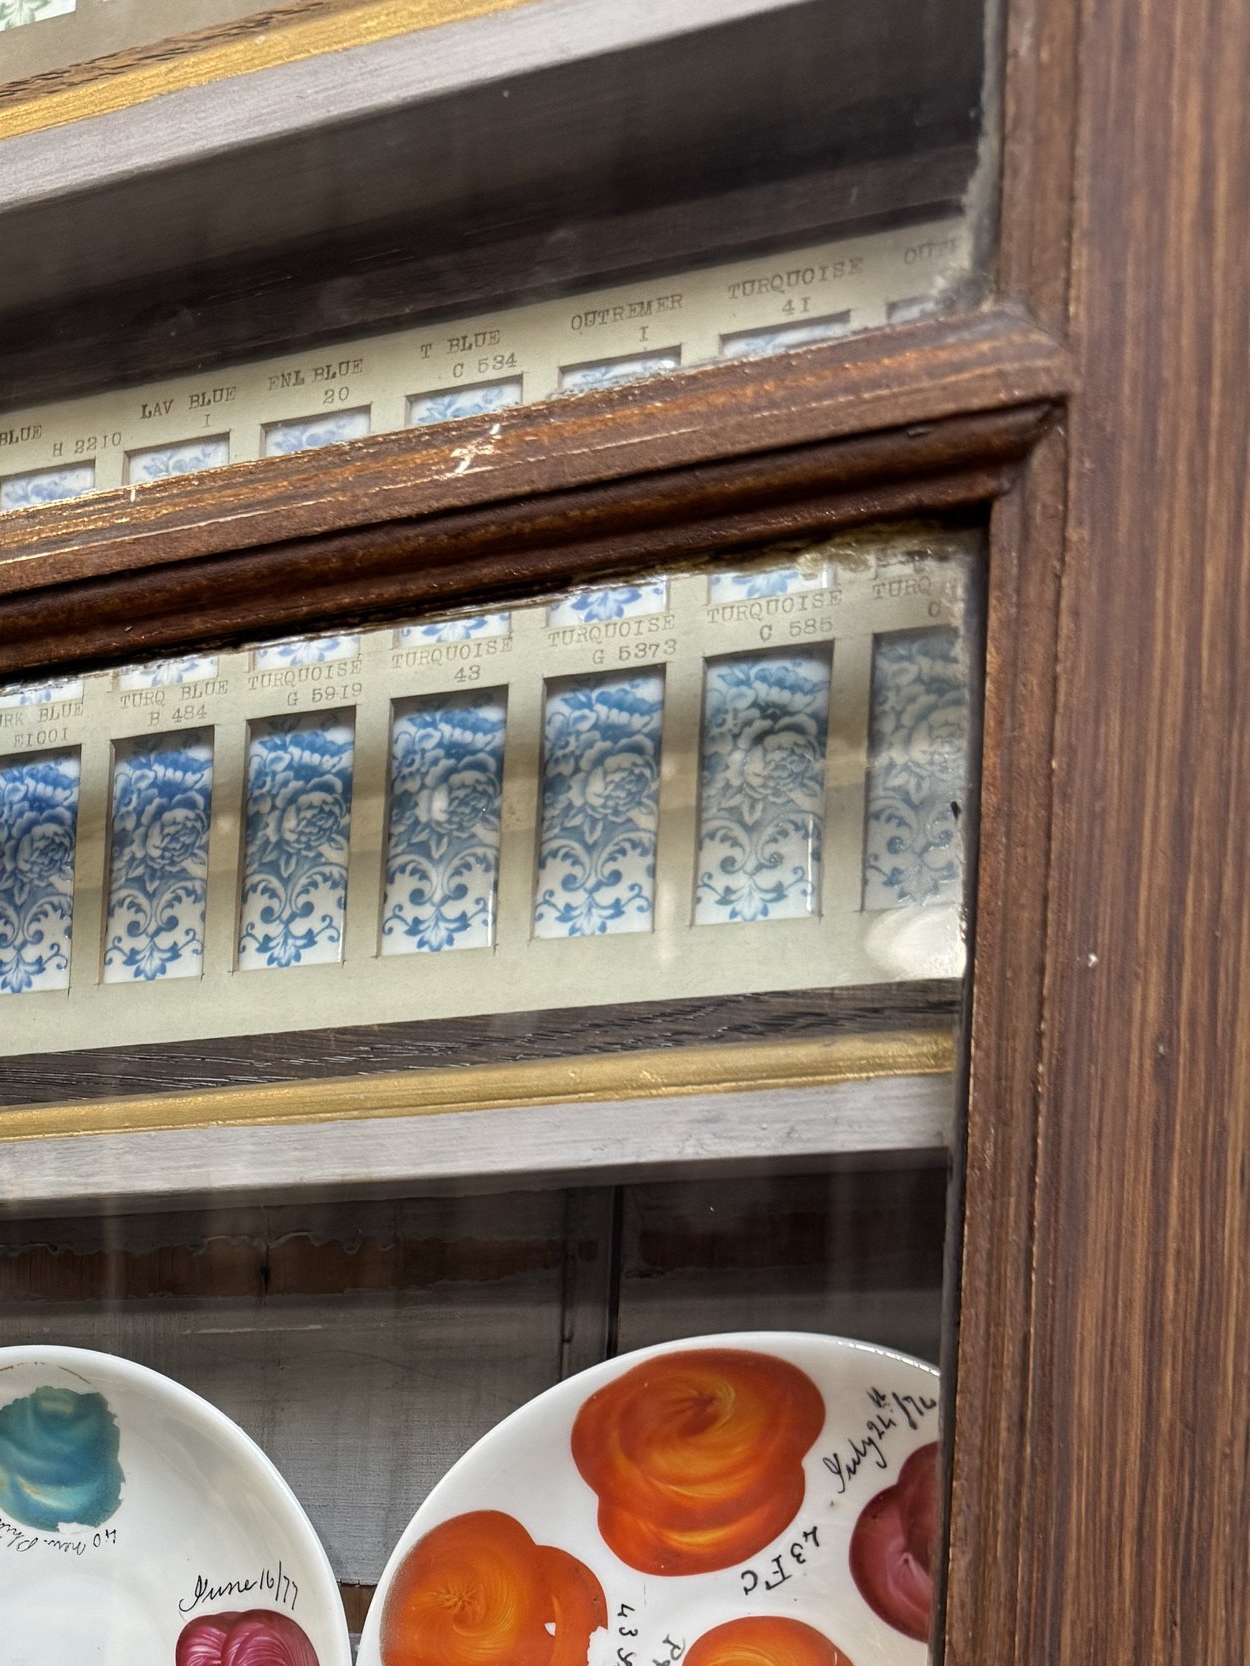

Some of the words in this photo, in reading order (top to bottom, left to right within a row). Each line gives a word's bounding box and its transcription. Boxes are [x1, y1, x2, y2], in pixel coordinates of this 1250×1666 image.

[728, 256, 863, 300] TURQUOISE
[570, 293, 683, 331] OUTREMER
[420, 343, 432, 359] T
[447, 329, 500, 354] BLUE
[311, 358, 364, 383] BLUE
[477, 352, 518, 374] 534
[141, 400, 174, 420] LAV
[188, 386, 237, 410] BLUE
[322, 386, 350, 406] 20
[52, 442, 63, 458] H
[706, 590, 843, 624] TURQUOISE
[548, 614, 676, 647] TURQUOISE
[789, 617, 833, 638] 585
[391, 636, 513, 669] TURQUOISE
[593, 650, 605, 665] G
[618, 639, 677, 662] 5373
[247, 660, 362, 691] TURQUOISE
[454, 664, 481, 683] 43
[120, 690, 165, 710] TURQ
[180, 679, 229, 701] BLUE
[287, 691, 298, 707] G
[38, 701, 84, 723] BLUE
[172, 704, 208, 723] 484
